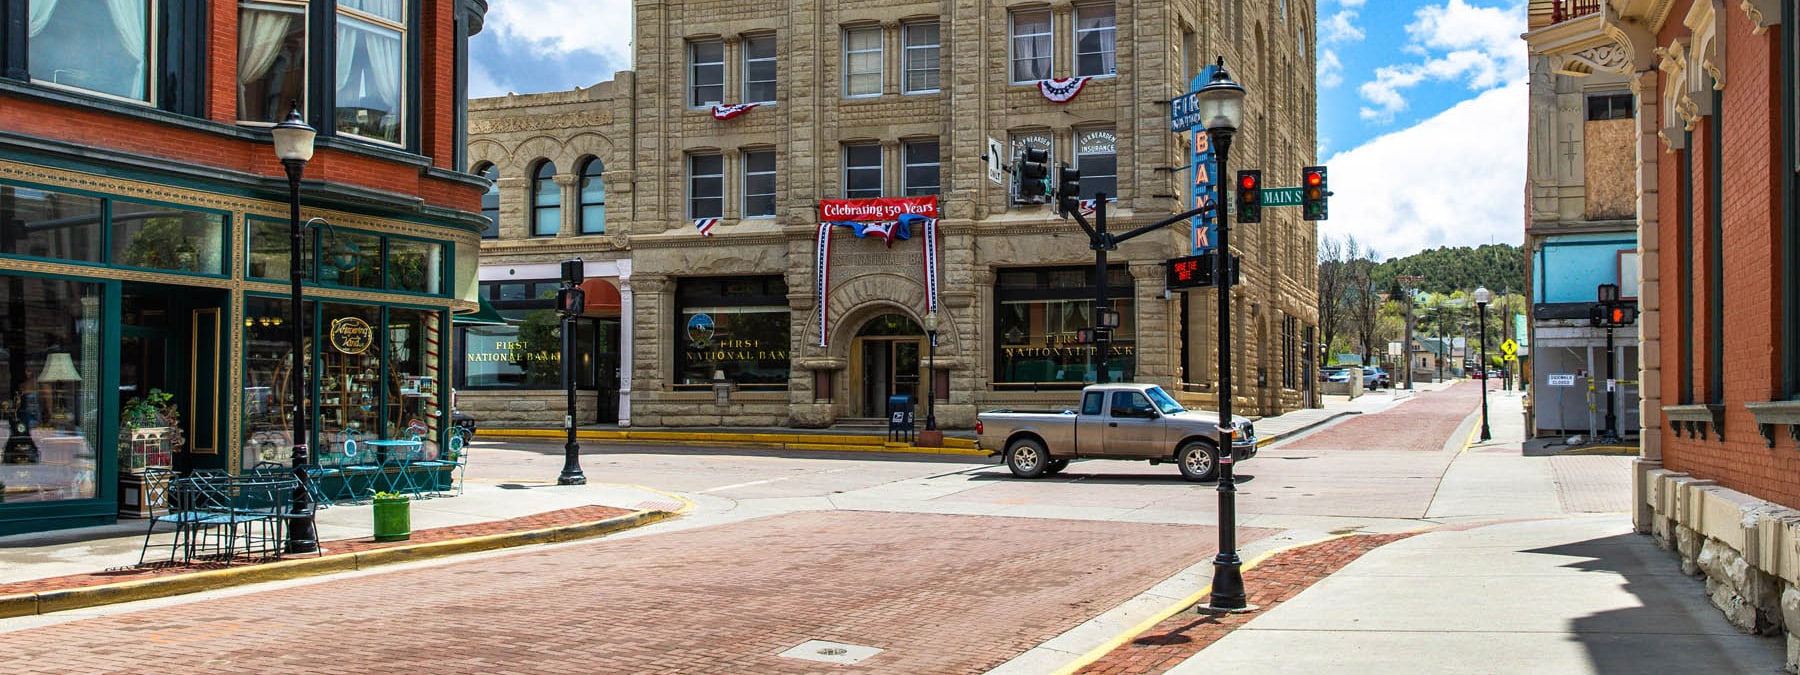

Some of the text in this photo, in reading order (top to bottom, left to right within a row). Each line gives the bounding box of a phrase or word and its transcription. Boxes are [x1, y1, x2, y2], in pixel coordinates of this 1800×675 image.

[1173, 94, 1200, 118] FIR
[1171, 113, 1200, 130] NATIO
[1081, 144, 1115, 153] INSURANCE
[1195, 131, 1209, 248] BANK
[1264, 190, 1303, 204] MAIN S
[824, 202, 934, 217] Celebrating 150 Years
[909, 253, 922, 265] BA
[720, 339, 759, 348] FIRST
[1045, 334, 1078, 344] FIRS
[496, 341, 529, 350] FIRST
[467, 353, 523, 361] NATIONAL
[687, 351, 754, 360] NATIONAL
[1005, 346, 1133, 357] NATIONAL BNK
